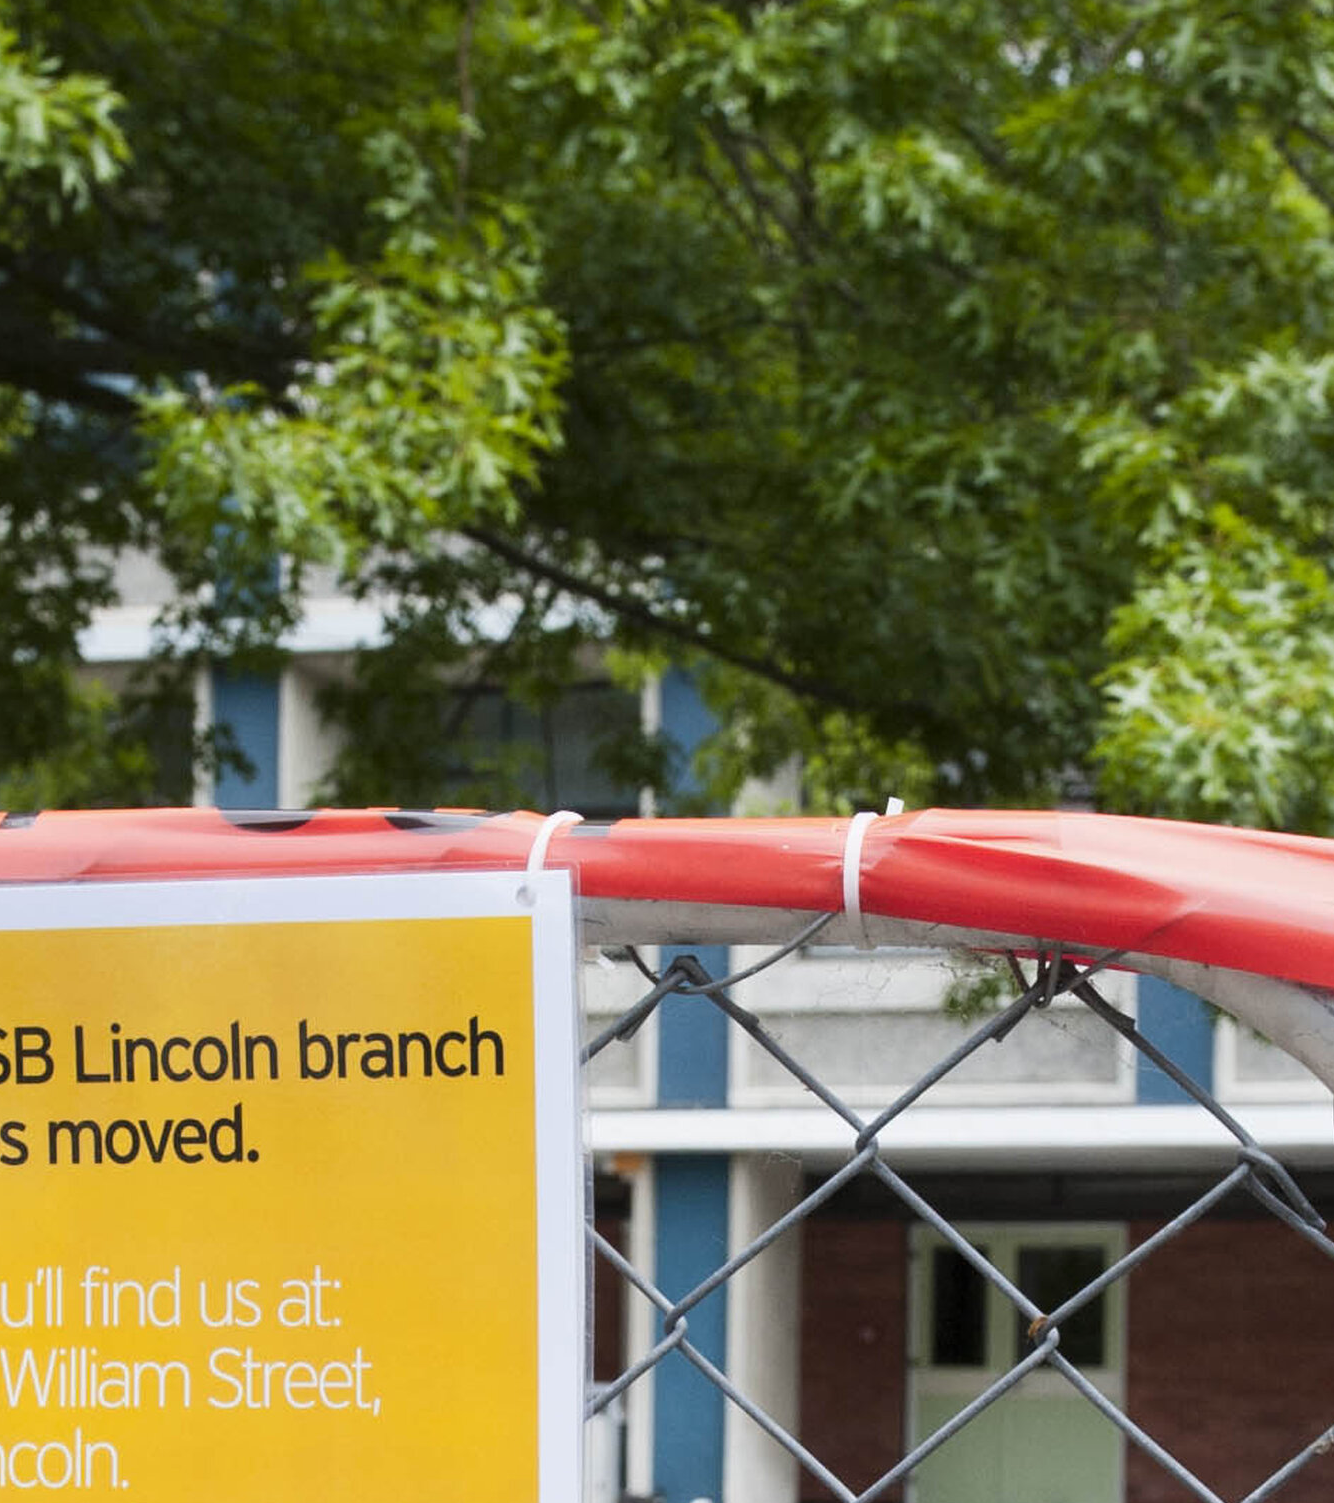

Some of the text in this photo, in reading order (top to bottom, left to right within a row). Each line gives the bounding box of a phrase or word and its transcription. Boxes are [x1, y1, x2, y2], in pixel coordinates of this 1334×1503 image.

[75, 1021, 278, 1083] Lincoln
[299, 1016, 504, 1080] branch
[48, 1102, 259, 1164] moved.
[80, 1265, 181, 1328] find
[200, 1279, 262, 1327] us
[277, 1265, 341, 1327] at:
[0, 1347, 191, 1408] William
[208, 1347, 381, 1416] Street,
